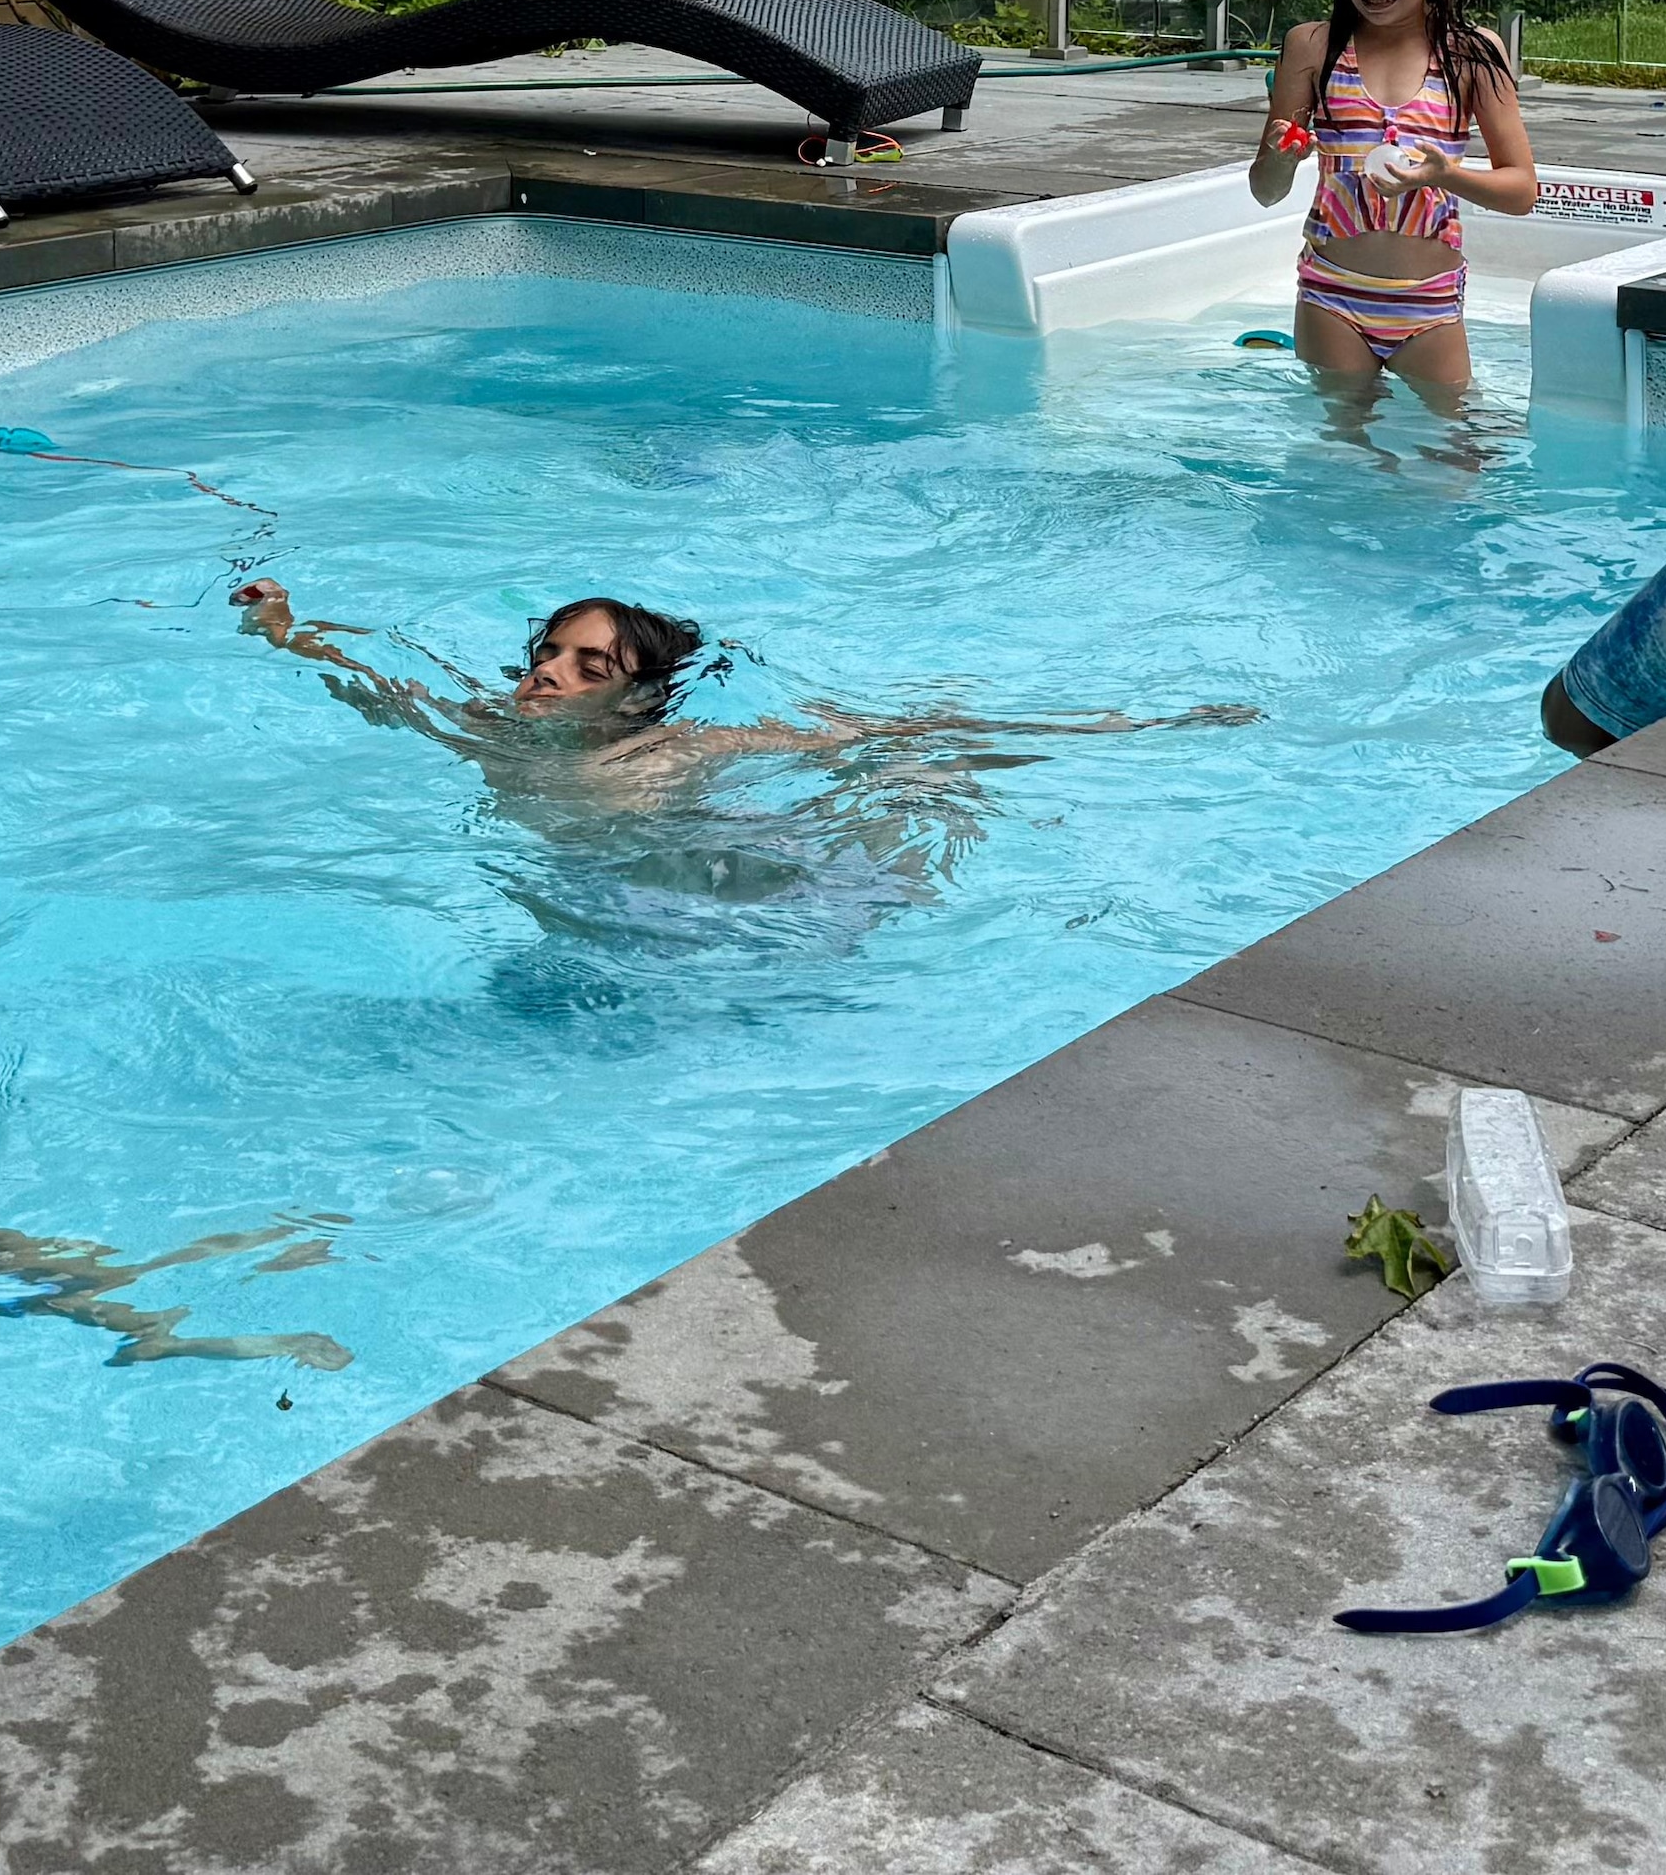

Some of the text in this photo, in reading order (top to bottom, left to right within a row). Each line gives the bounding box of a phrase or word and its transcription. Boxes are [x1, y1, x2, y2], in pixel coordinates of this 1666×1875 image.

[1539, 183, 1643, 204] DANGER
[1561, 199, 1591, 208] Water
[1603, 202, 1617, 211] No
[1619, 204, 1651, 215] Diving
